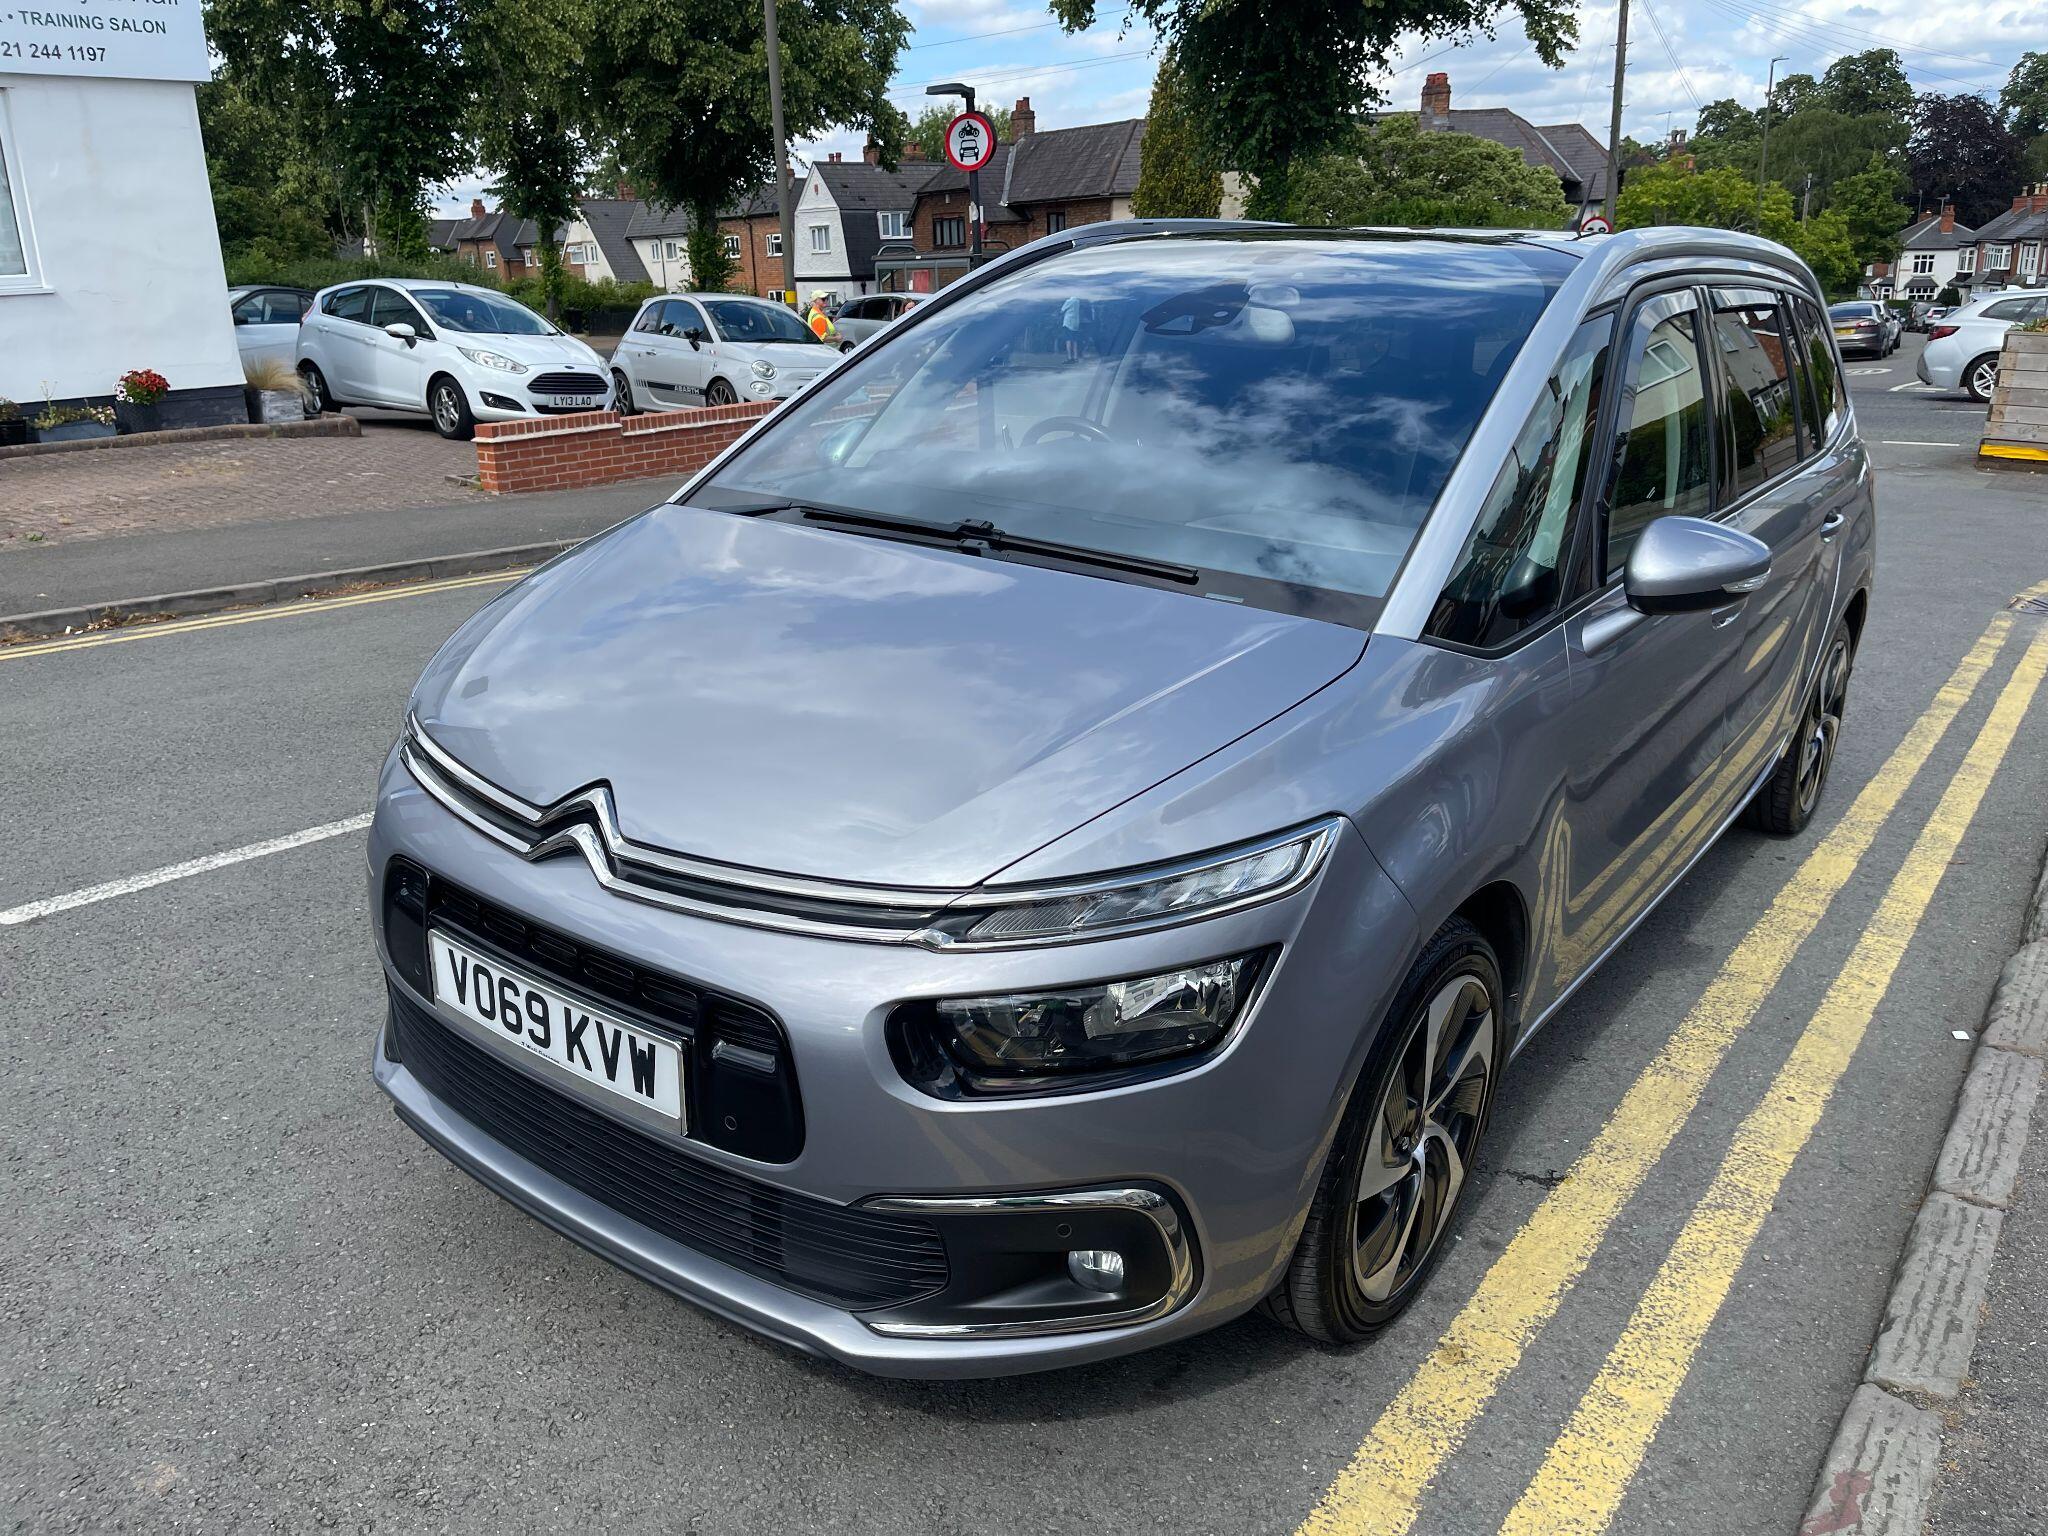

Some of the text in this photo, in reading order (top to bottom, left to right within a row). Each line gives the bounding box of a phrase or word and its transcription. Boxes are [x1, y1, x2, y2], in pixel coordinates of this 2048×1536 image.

[18, 10, 167, 34] TRAINING SALON
[28, 43, 62, 59] 244
[67, 46, 106, 62] 1197
[554, 397, 574, 407] LY13
[448, 948, 656, 1100] VO69 KVW
